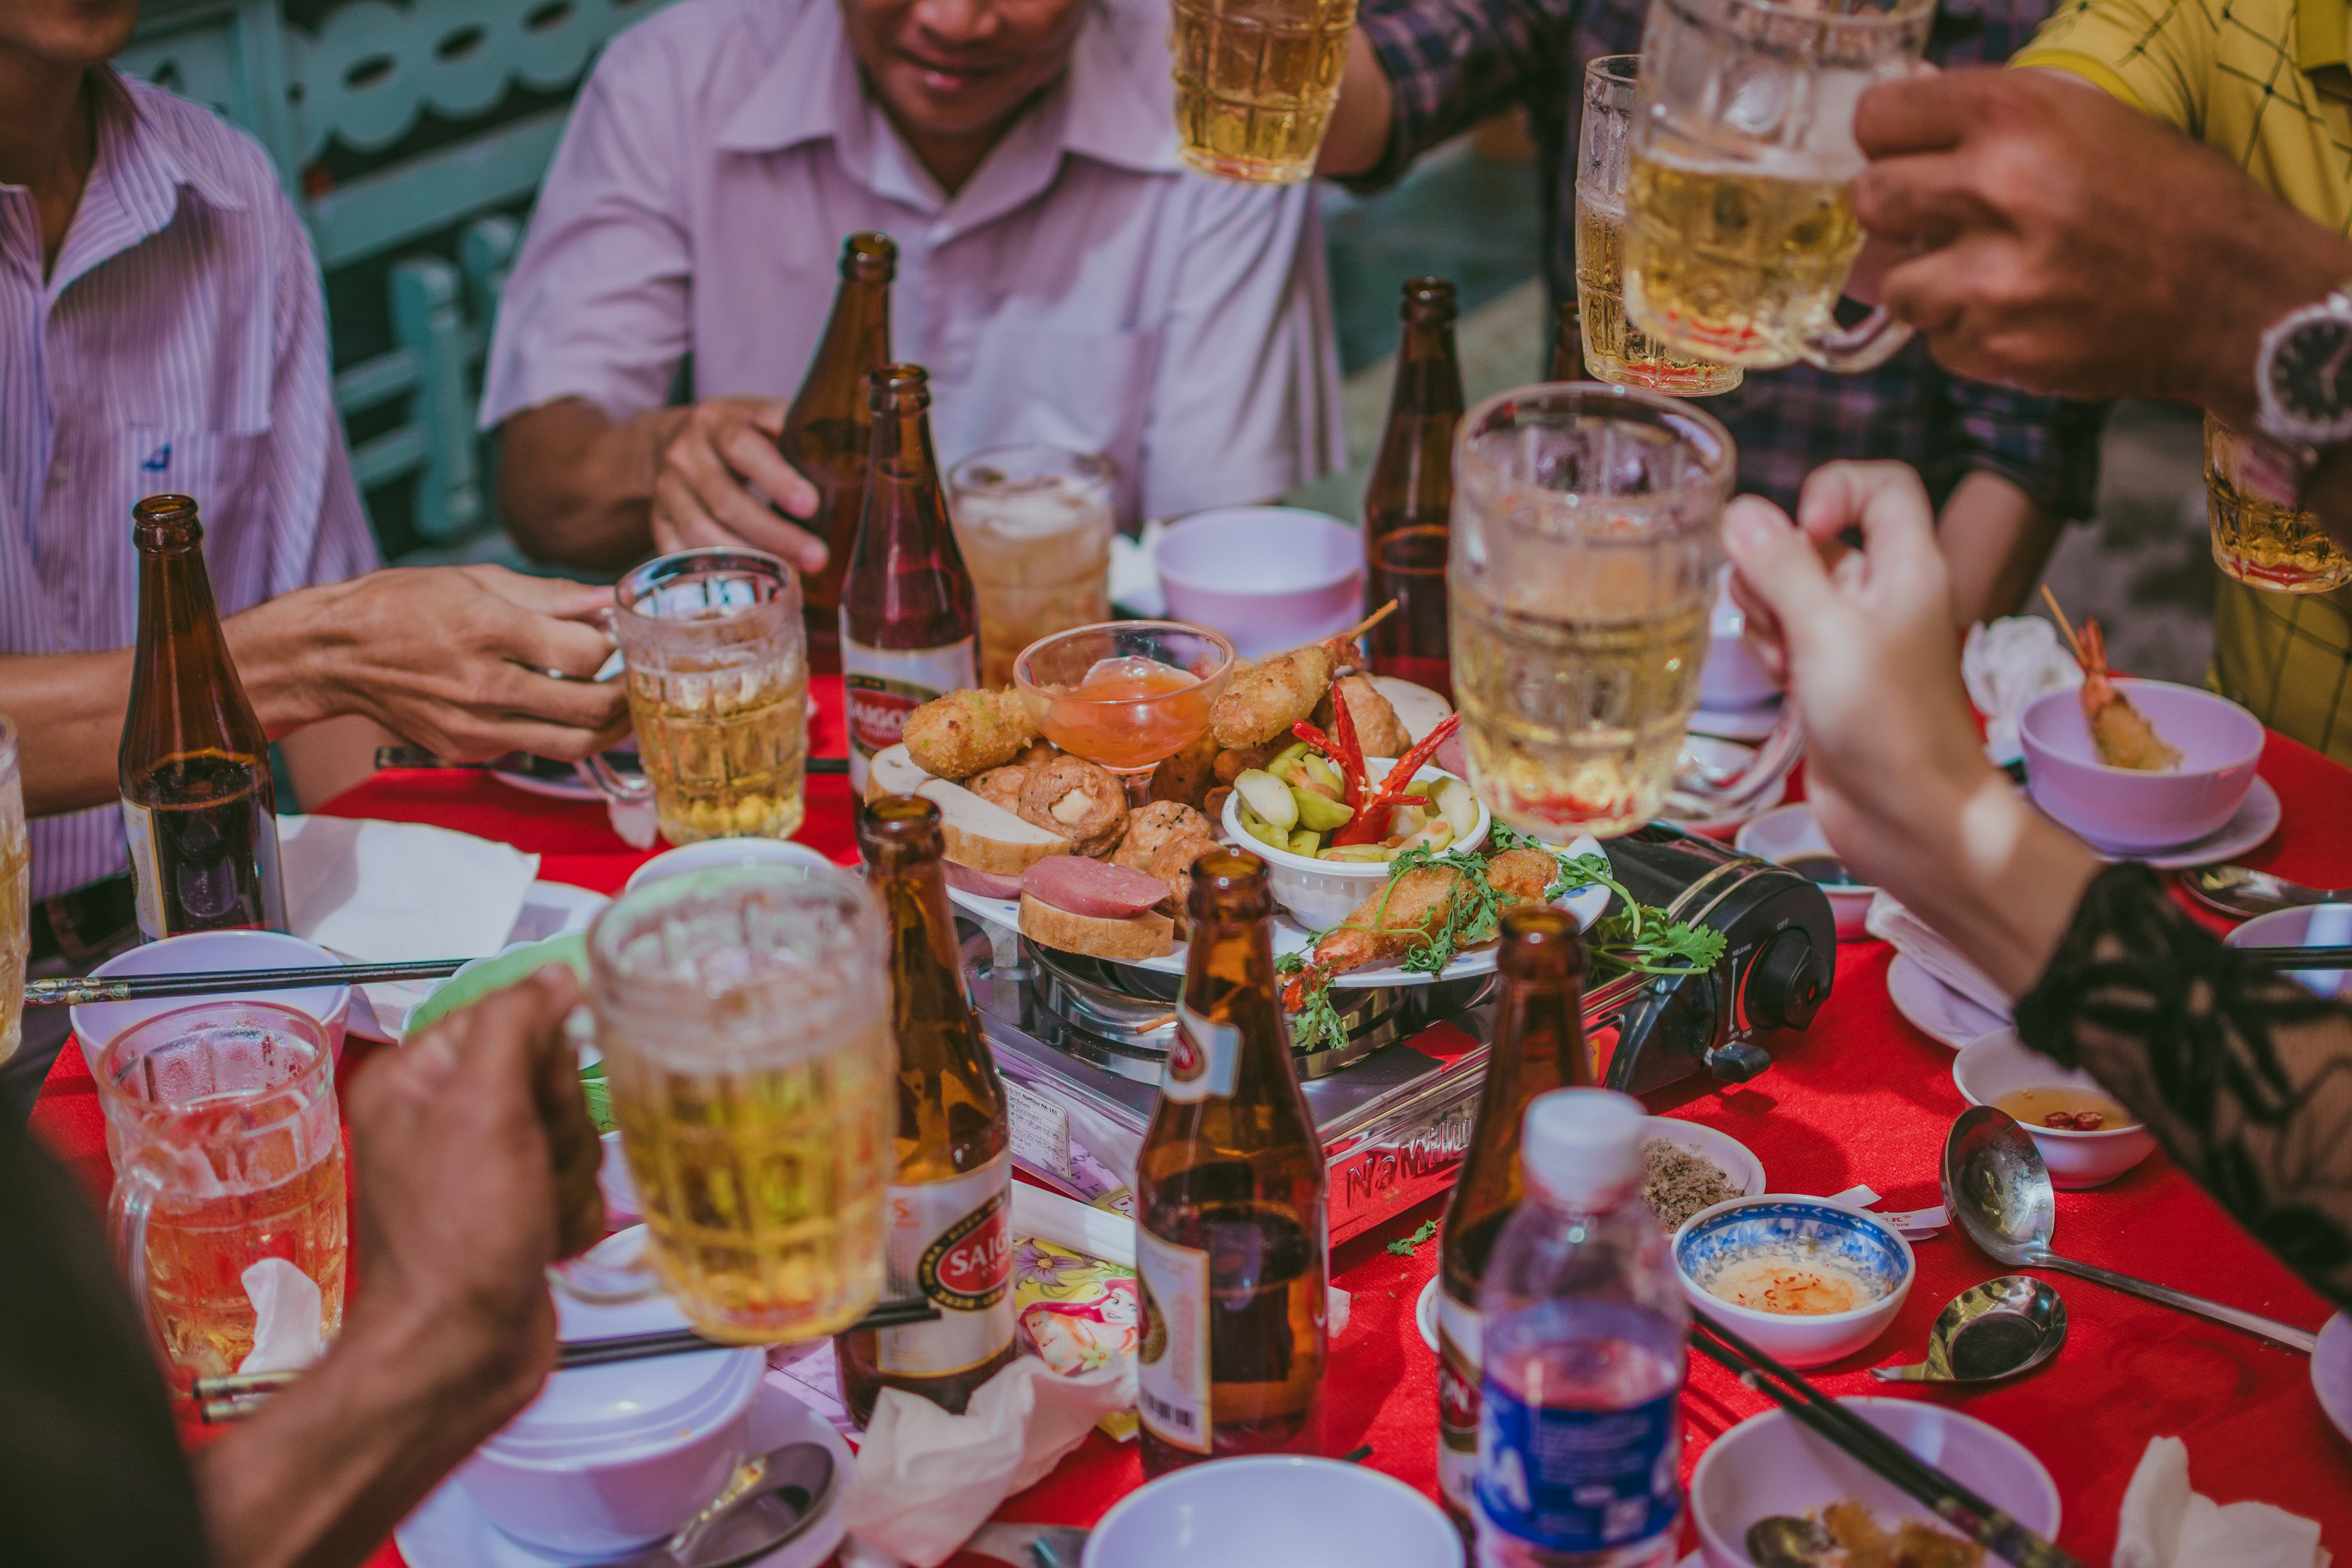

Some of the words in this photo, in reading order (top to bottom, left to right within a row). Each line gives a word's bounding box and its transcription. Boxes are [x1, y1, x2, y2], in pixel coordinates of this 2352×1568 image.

[1777, 919, 1789, 930] OFF
[1733, 943, 1752, 956] RELEASE
[1743, 1029, 1752, 1038] ON
[1022, 1094, 1040, 1106] NaMilux
[1041, 1104, 1057, 1115] NA-161
